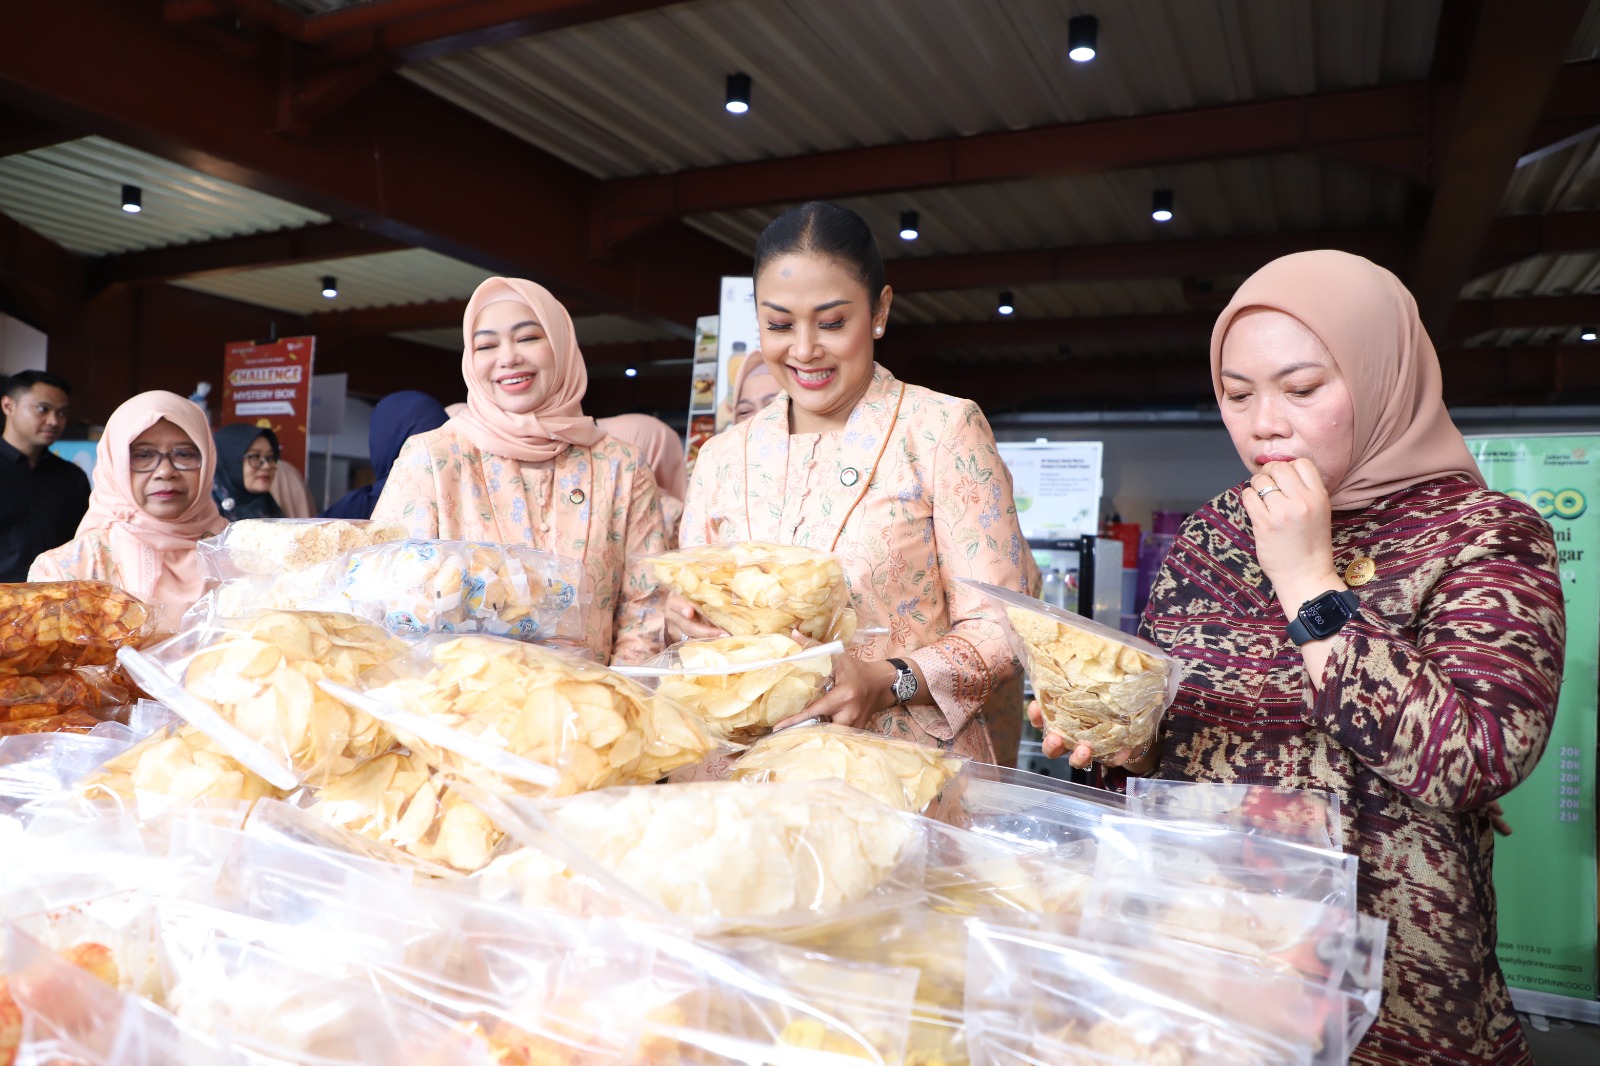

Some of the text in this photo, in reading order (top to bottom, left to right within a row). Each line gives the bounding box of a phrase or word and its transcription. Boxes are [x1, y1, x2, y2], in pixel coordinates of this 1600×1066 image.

[231, 366, 302, 387] CHALLENGE
[233, 389, 297, 401] MYSTERY BOX
[1560, 746, 1580, 757] 20K
[1560, 760, 1580, 770] 20K
[1560, 773, 1580, 783] 20K
[1560, 786, 1580, 796] 20K
[1560, 799, 1580, 809] 20K
[1560, 812, 1580, 822] 25K
